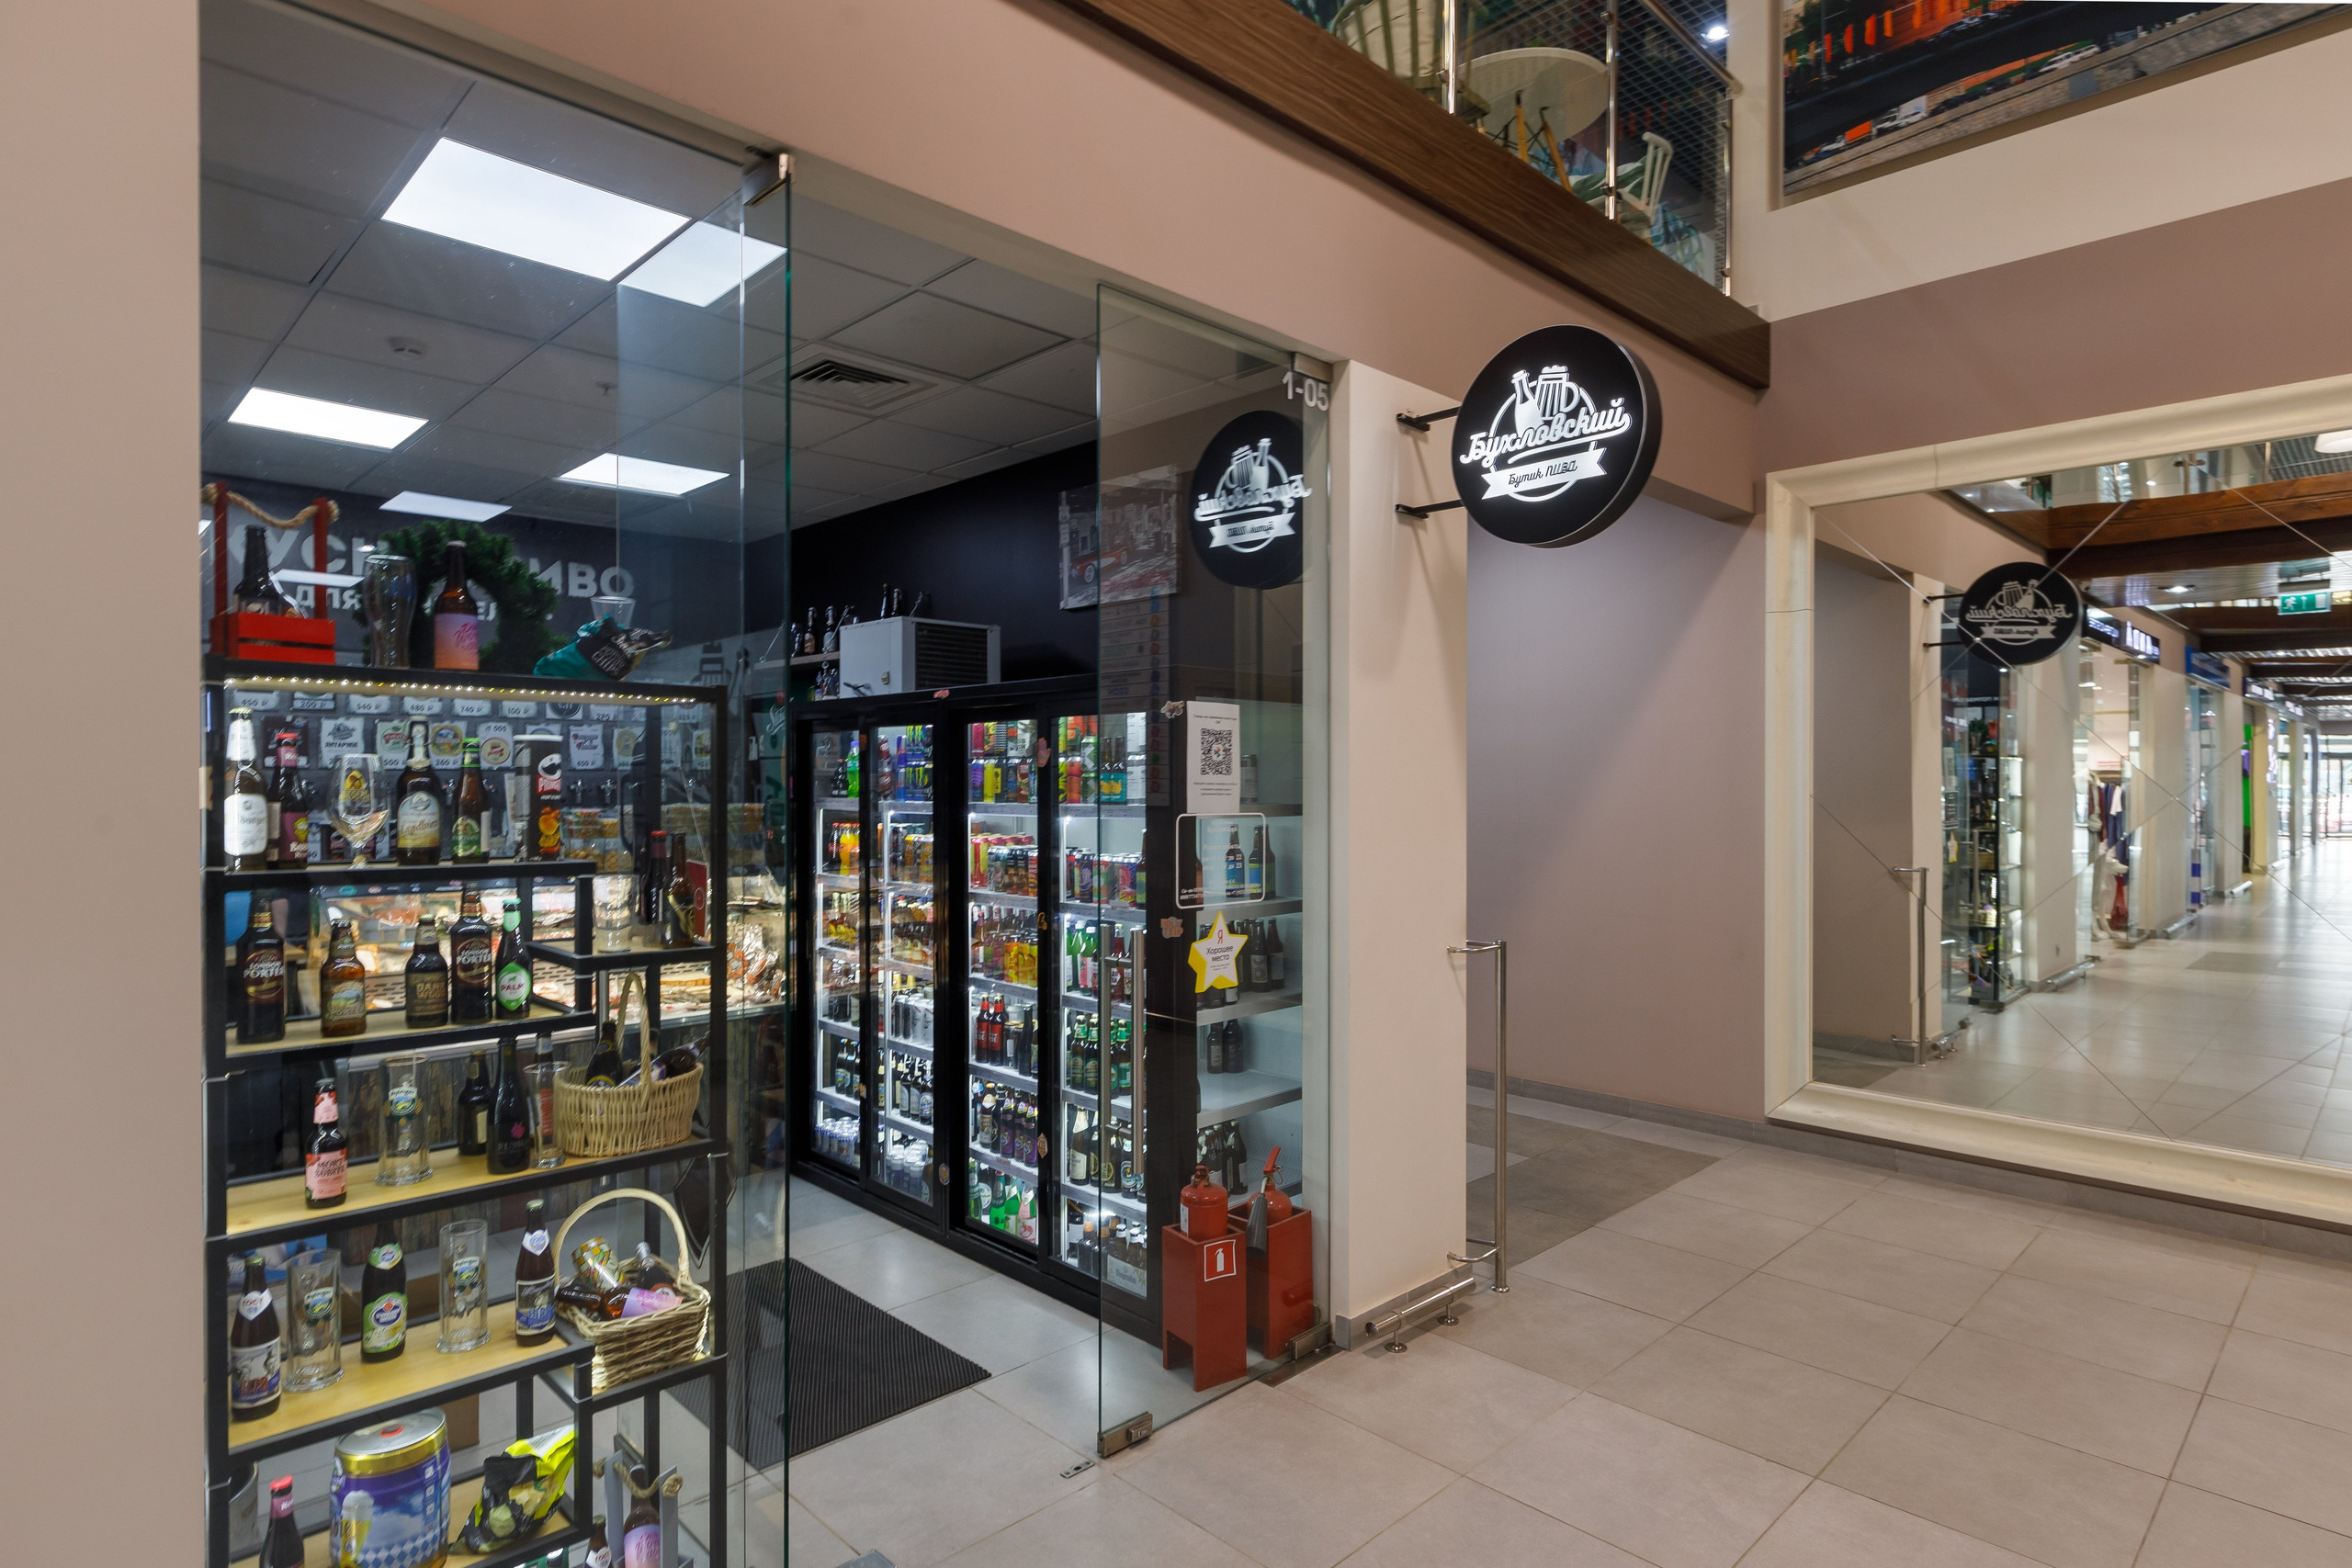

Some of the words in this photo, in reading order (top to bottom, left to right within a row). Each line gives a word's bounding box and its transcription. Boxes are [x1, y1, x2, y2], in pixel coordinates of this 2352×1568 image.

[1282, 371, 1329, 412] 1-05
[1460, 398, 1632, 468] Бухловский
[1508, 468, 1544, 488] Бутик
[1216, 929, 1223, 944] Я
[1206, 946, 1234, 955] Хорошее
[1211, 954, 1230, 963] место
[500, 983, 525, 992] PALM
